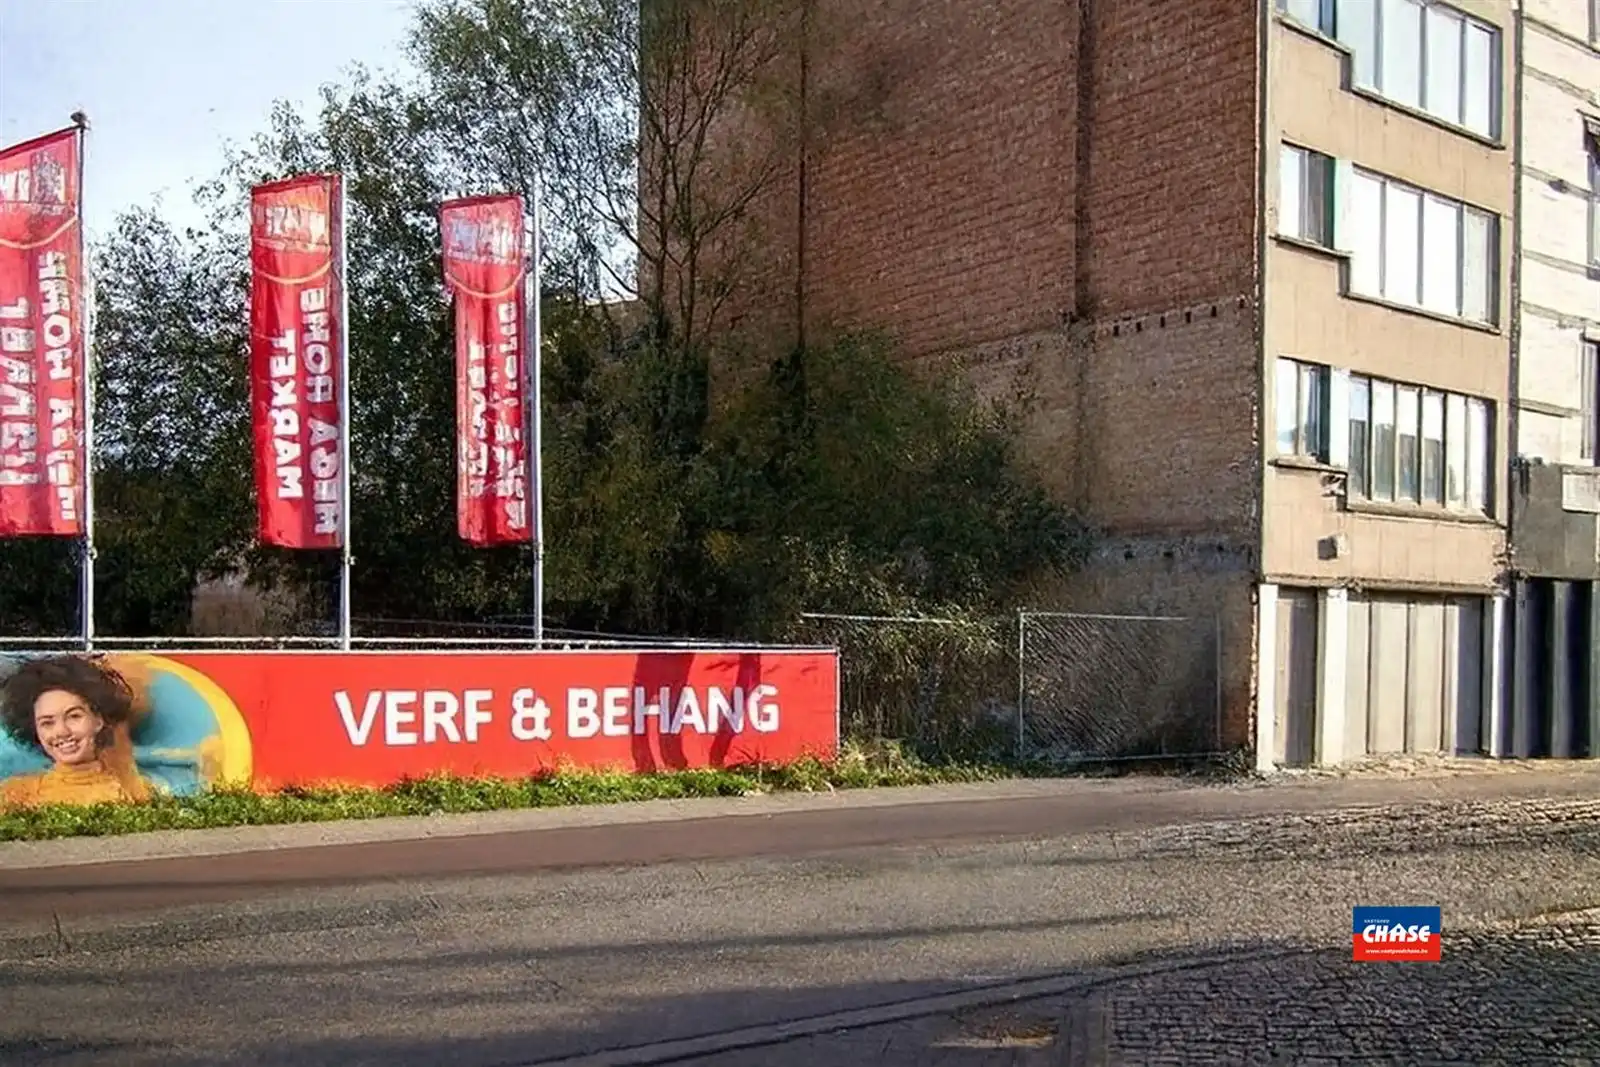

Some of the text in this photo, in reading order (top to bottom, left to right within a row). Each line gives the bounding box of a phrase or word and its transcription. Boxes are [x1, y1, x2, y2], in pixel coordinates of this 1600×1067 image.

[333, 684, 781, 746] VERF & BEHANG
